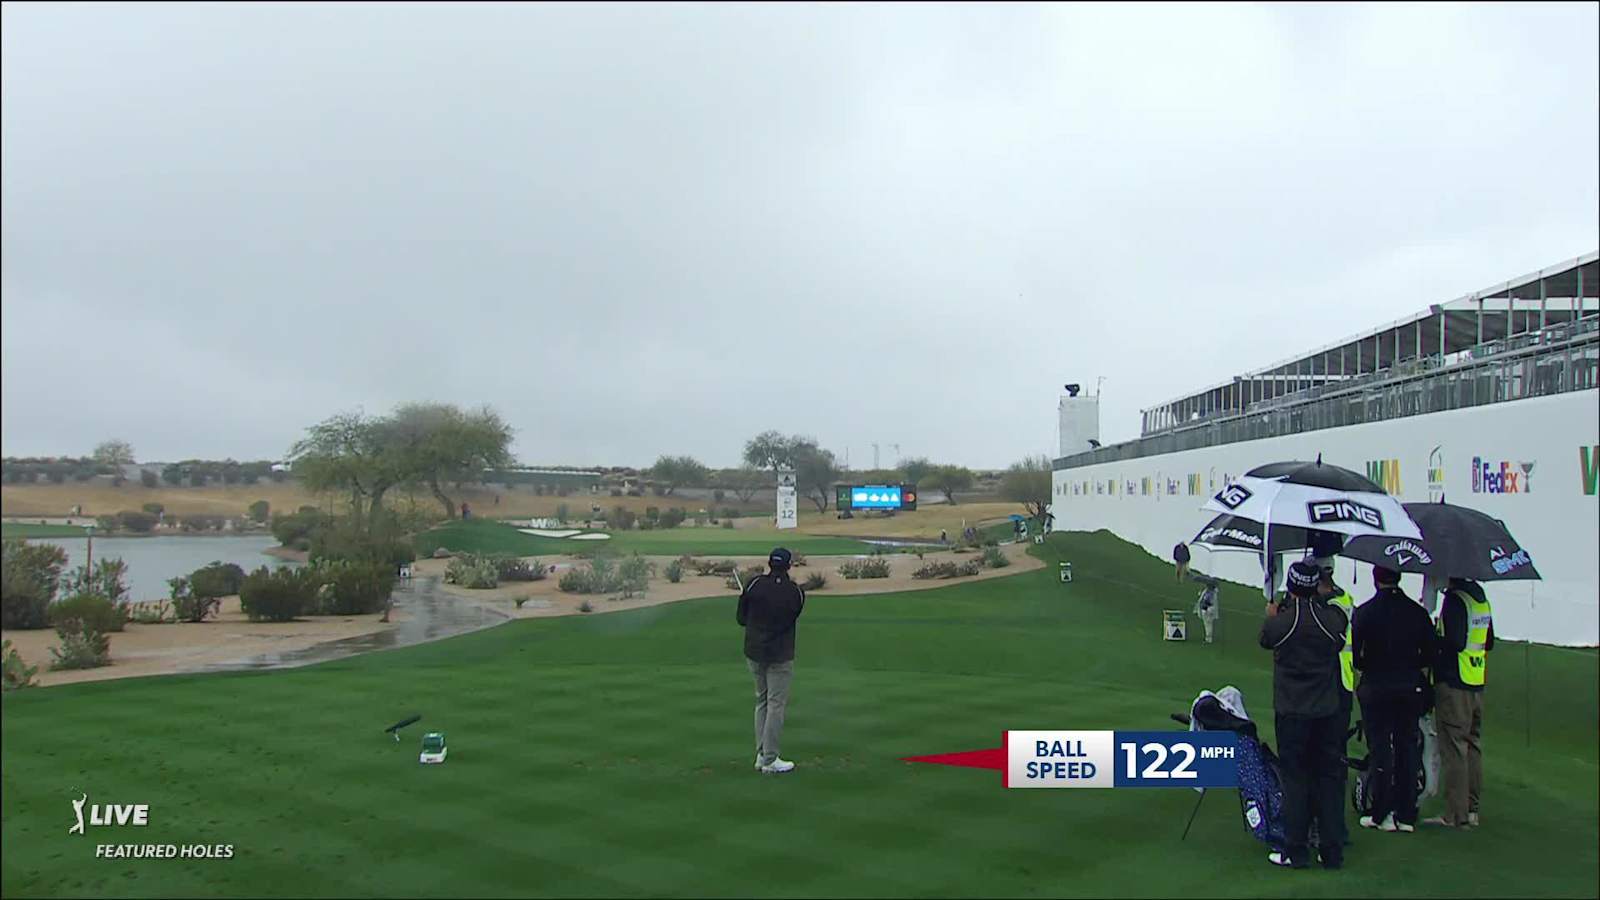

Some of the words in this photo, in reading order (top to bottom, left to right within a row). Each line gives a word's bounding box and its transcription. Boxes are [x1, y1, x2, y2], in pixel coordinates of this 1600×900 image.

[1483, 461, 1518, 493] FedEx
[782, 510, 794, 518] 12
[1313, 503, 1380, 526] PING
[1385, 540, 1432, 563] Callaway
